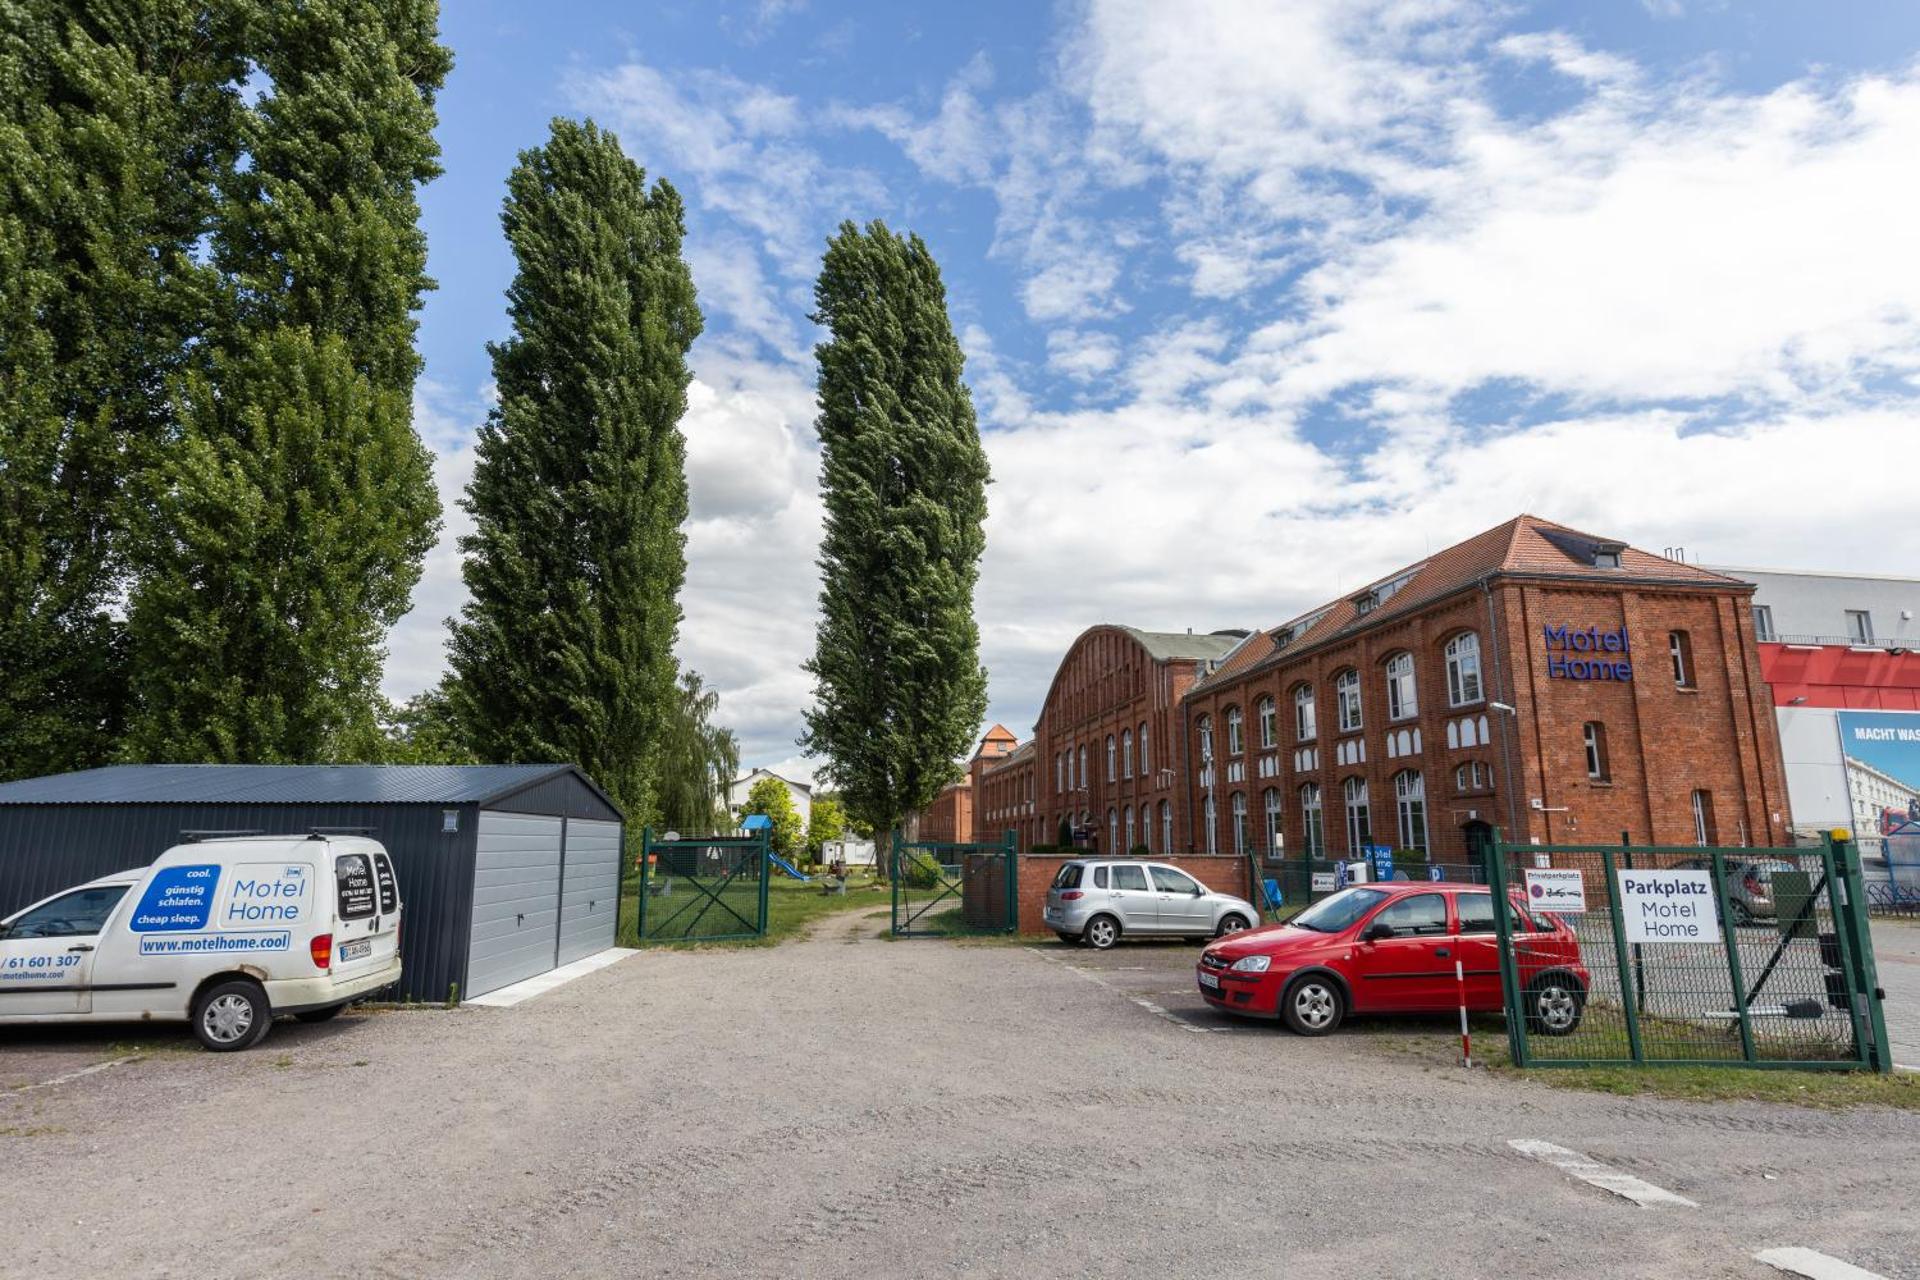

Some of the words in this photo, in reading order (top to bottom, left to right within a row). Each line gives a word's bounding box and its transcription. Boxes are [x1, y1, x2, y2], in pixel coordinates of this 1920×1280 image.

[1544, 624, 1629, 652] Motel
[1547, 654, 1634, 682] Home
[1854, 728, 1895, 740] MACHT
[187, 869, 211, 878] cool.
[165, 885, 205, 896] günstig
[234, 879, 305, 897] Motel
[1625, 879, 1707, 898] Parkplatz
[158, 897, 203, 907] schlafen.
[1641, 901, 1697, 917] Motel
[228, 903, 299, 920] Home
[137, 915, 169, 925] cheap
[170, 914, 200, 924] sleep.
[1644, 921, 1698, 936] Home
[144, 934, 286, 951] www.motelhome.cool
[9, 957, 24, 968] 61
[28, 957, 52, 968] 601
[56, 955, 81, 967] 307
